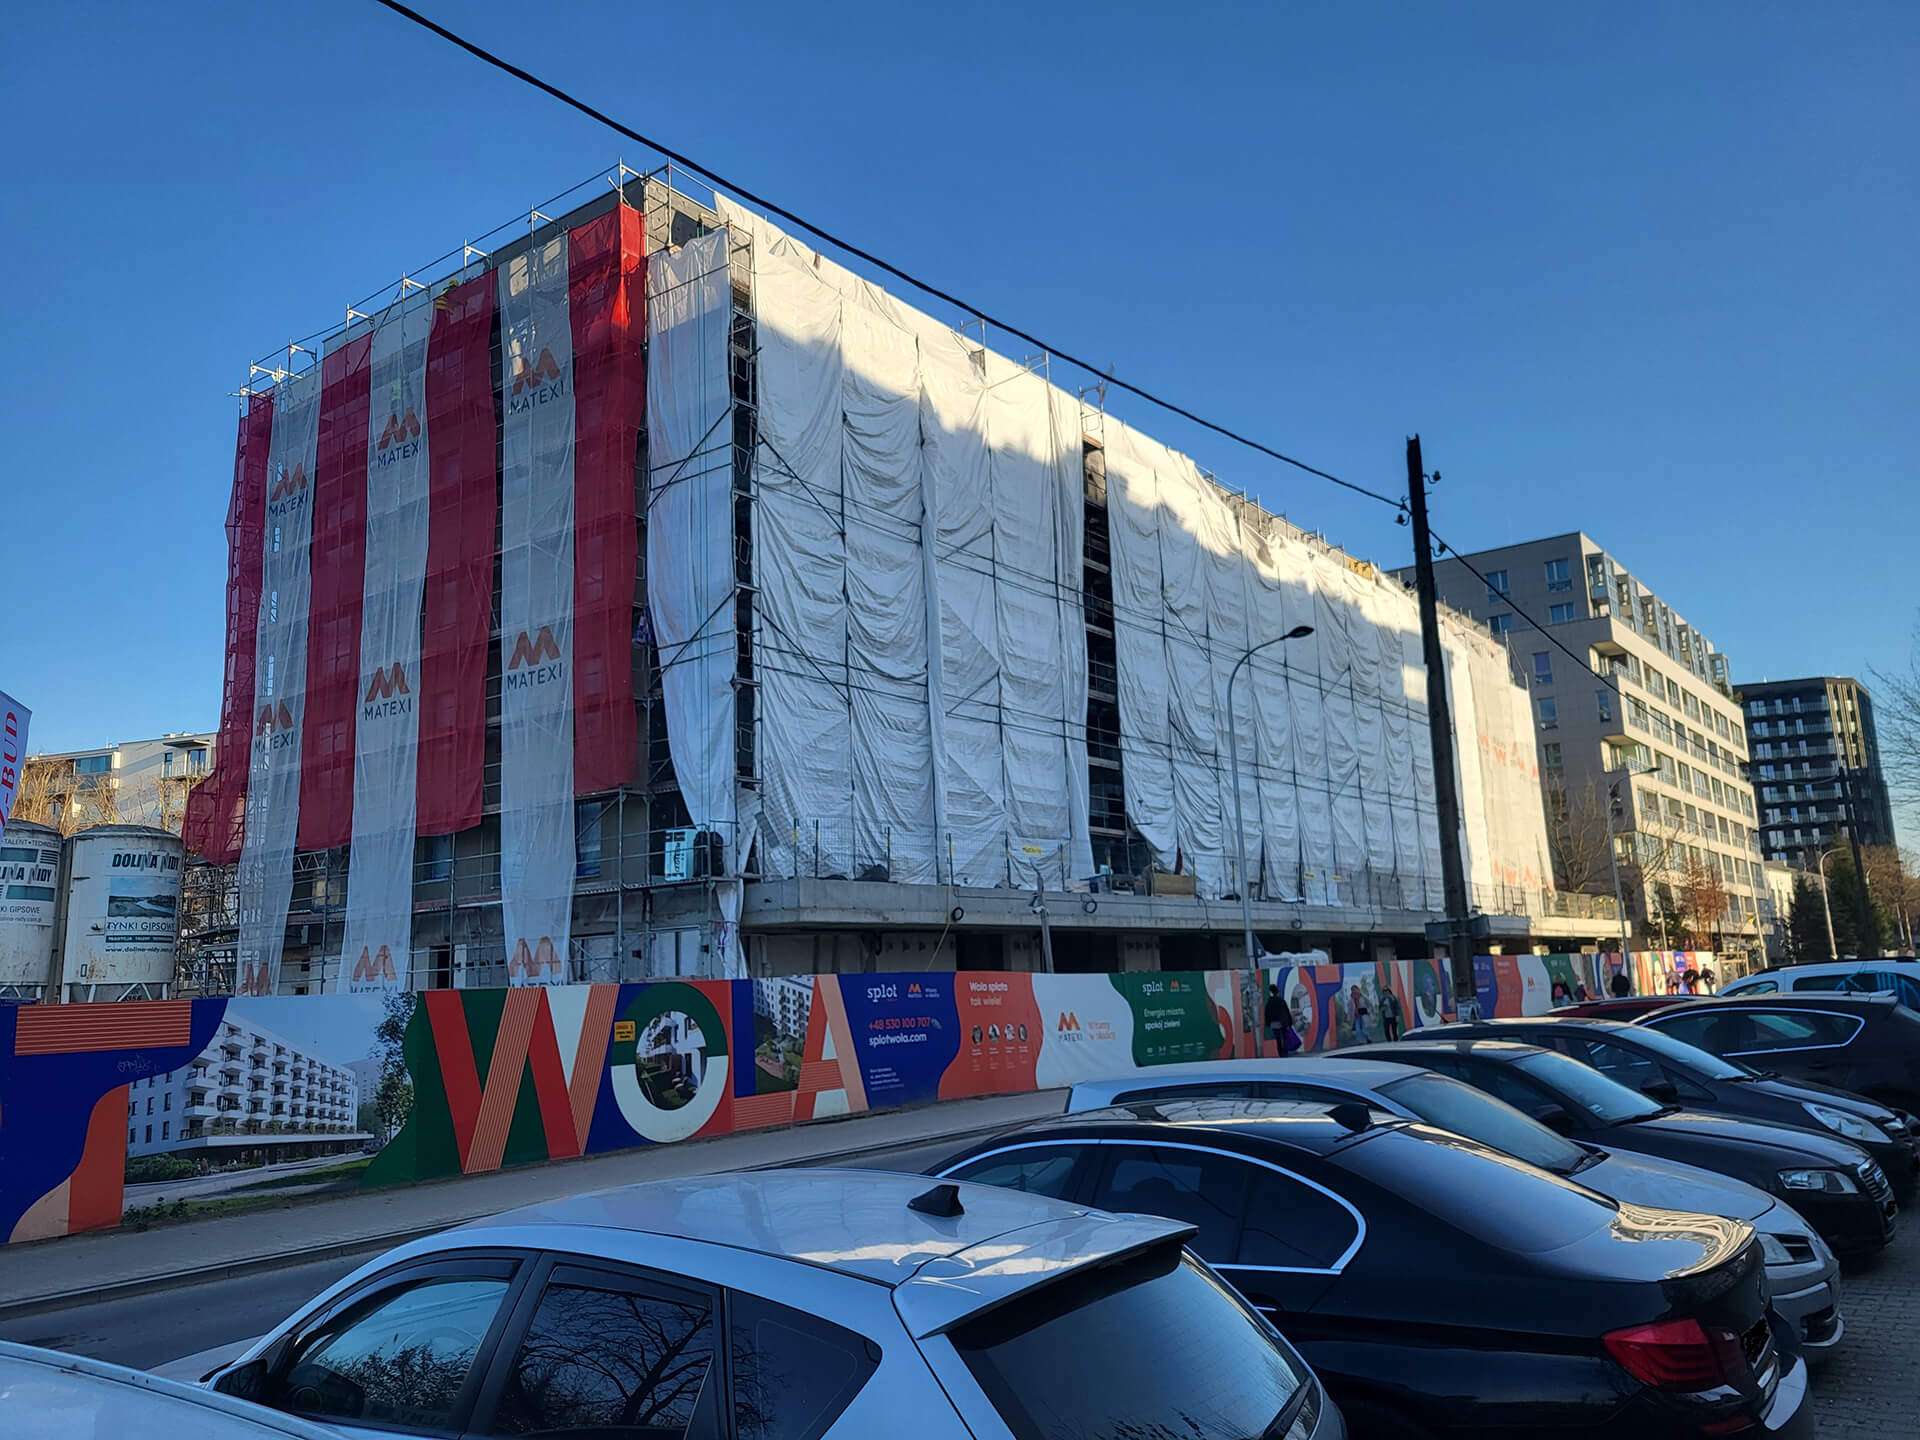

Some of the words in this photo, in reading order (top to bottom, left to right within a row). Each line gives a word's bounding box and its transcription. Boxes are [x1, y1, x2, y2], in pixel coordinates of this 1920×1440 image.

[508, 379, 565, 415] MATEXI
[376, 440, 422, 469] MATEXI
[269, 490, 309, 517] MATEXI
[506, 662, 563, 690] MATEXI
[363, 700, 412, 721] MATEXI
[112, 851, 159, 872] DOLINA
[27, 864, 52, 884] NIDY
[9, 905, 40, 914] GIPSOWE
[107, 922, 138, 930] TYNKI
[140, 922, 175, 931] GIPSOWE
[866, 983, 898, 1002] splot
[969, 981, 987, 991] Wola
[1142, 981, 1164, 996] splot
[869, 1020, 884, 1031] +48
[885, 1018, 901, 1030] 530
[902, 1017, 916, 1029] 100
[869, 1033, 928, 1048] splotwola.com
[424, 974, 870, 1175] WOLA
